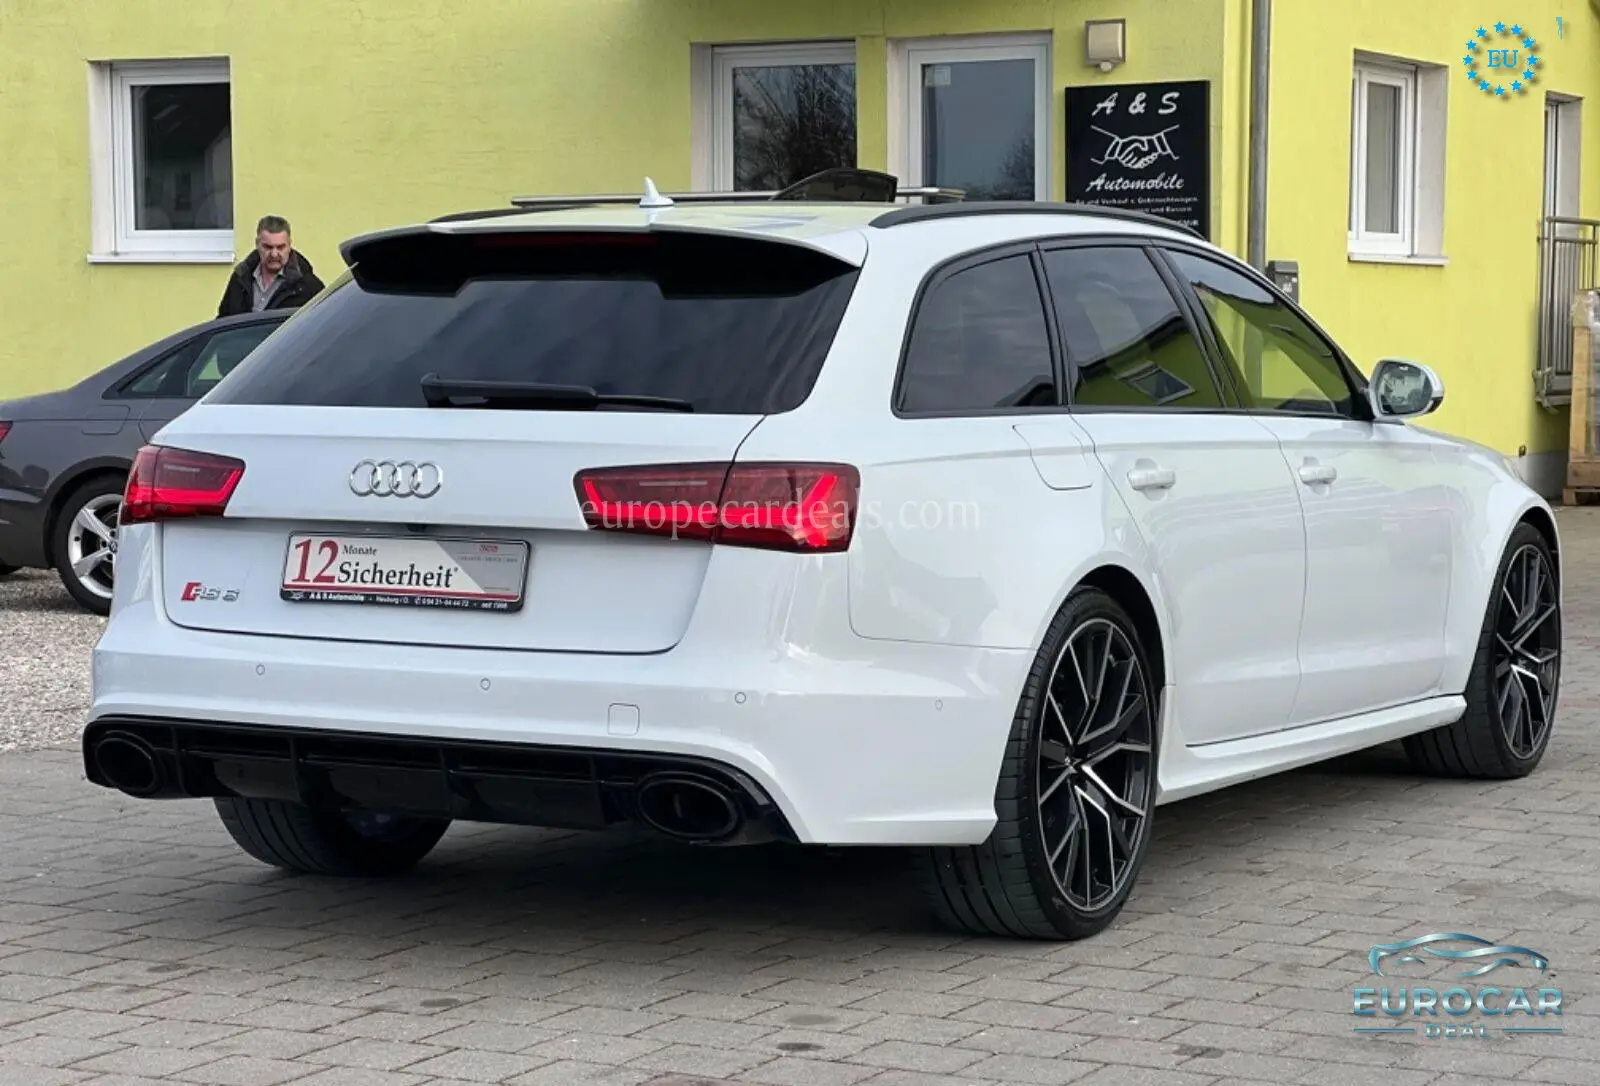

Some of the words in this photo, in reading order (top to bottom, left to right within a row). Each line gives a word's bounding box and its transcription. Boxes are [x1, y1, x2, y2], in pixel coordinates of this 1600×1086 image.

[1091, 92, 1119, 117] A
[1128, 91, 1147, 115] &
[1158, 91, 1180, 115] S
[1085, 172, 1185, 192] Automobile
[291, 538, 339, 584] 12
[342, 544, 378, 555] Monate
